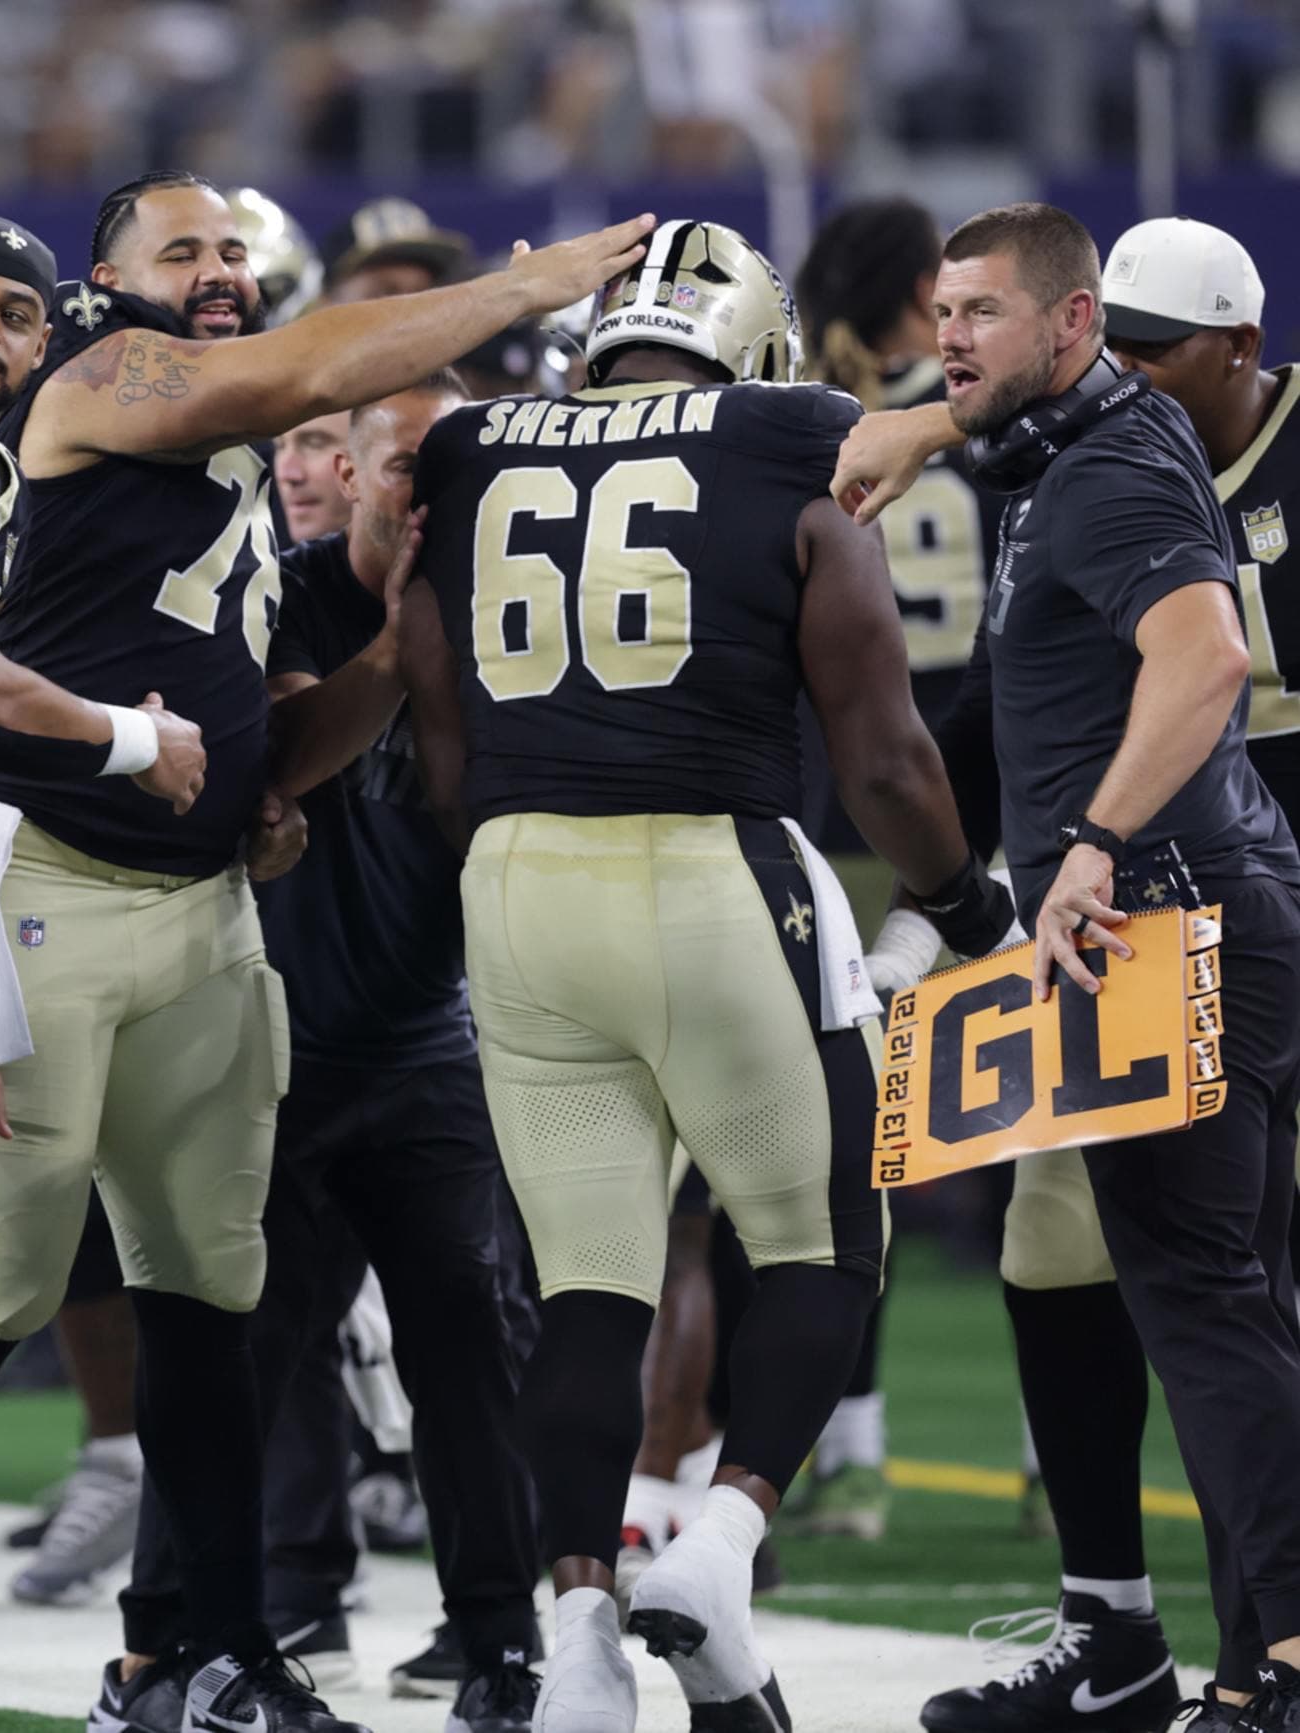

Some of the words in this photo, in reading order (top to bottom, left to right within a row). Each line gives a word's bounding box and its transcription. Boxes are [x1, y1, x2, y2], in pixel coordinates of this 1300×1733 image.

[595, 315, 622, 337] NEW
[626, 313, 695, 335] ORLEANS
[1100, 381, 1139, 411] SONY
[478, 390, 722, 446] SHERMAN
[1251, 528, 1283, 552] 60
[471, 456, 699, 702] 66
[894, 990, 917, 1021] 21
[1194, 1000, 1218, 1035] 10
[890, 1031, 913, 1062] 12
[928, 946, 1170, 1145] GL
[885, 1070, 909, 1103] 22
[1196, 1088, 1220, 1117] 01
[882, 1111, 906, 1141] 13
[879, 1152, 906, 1184] GL
